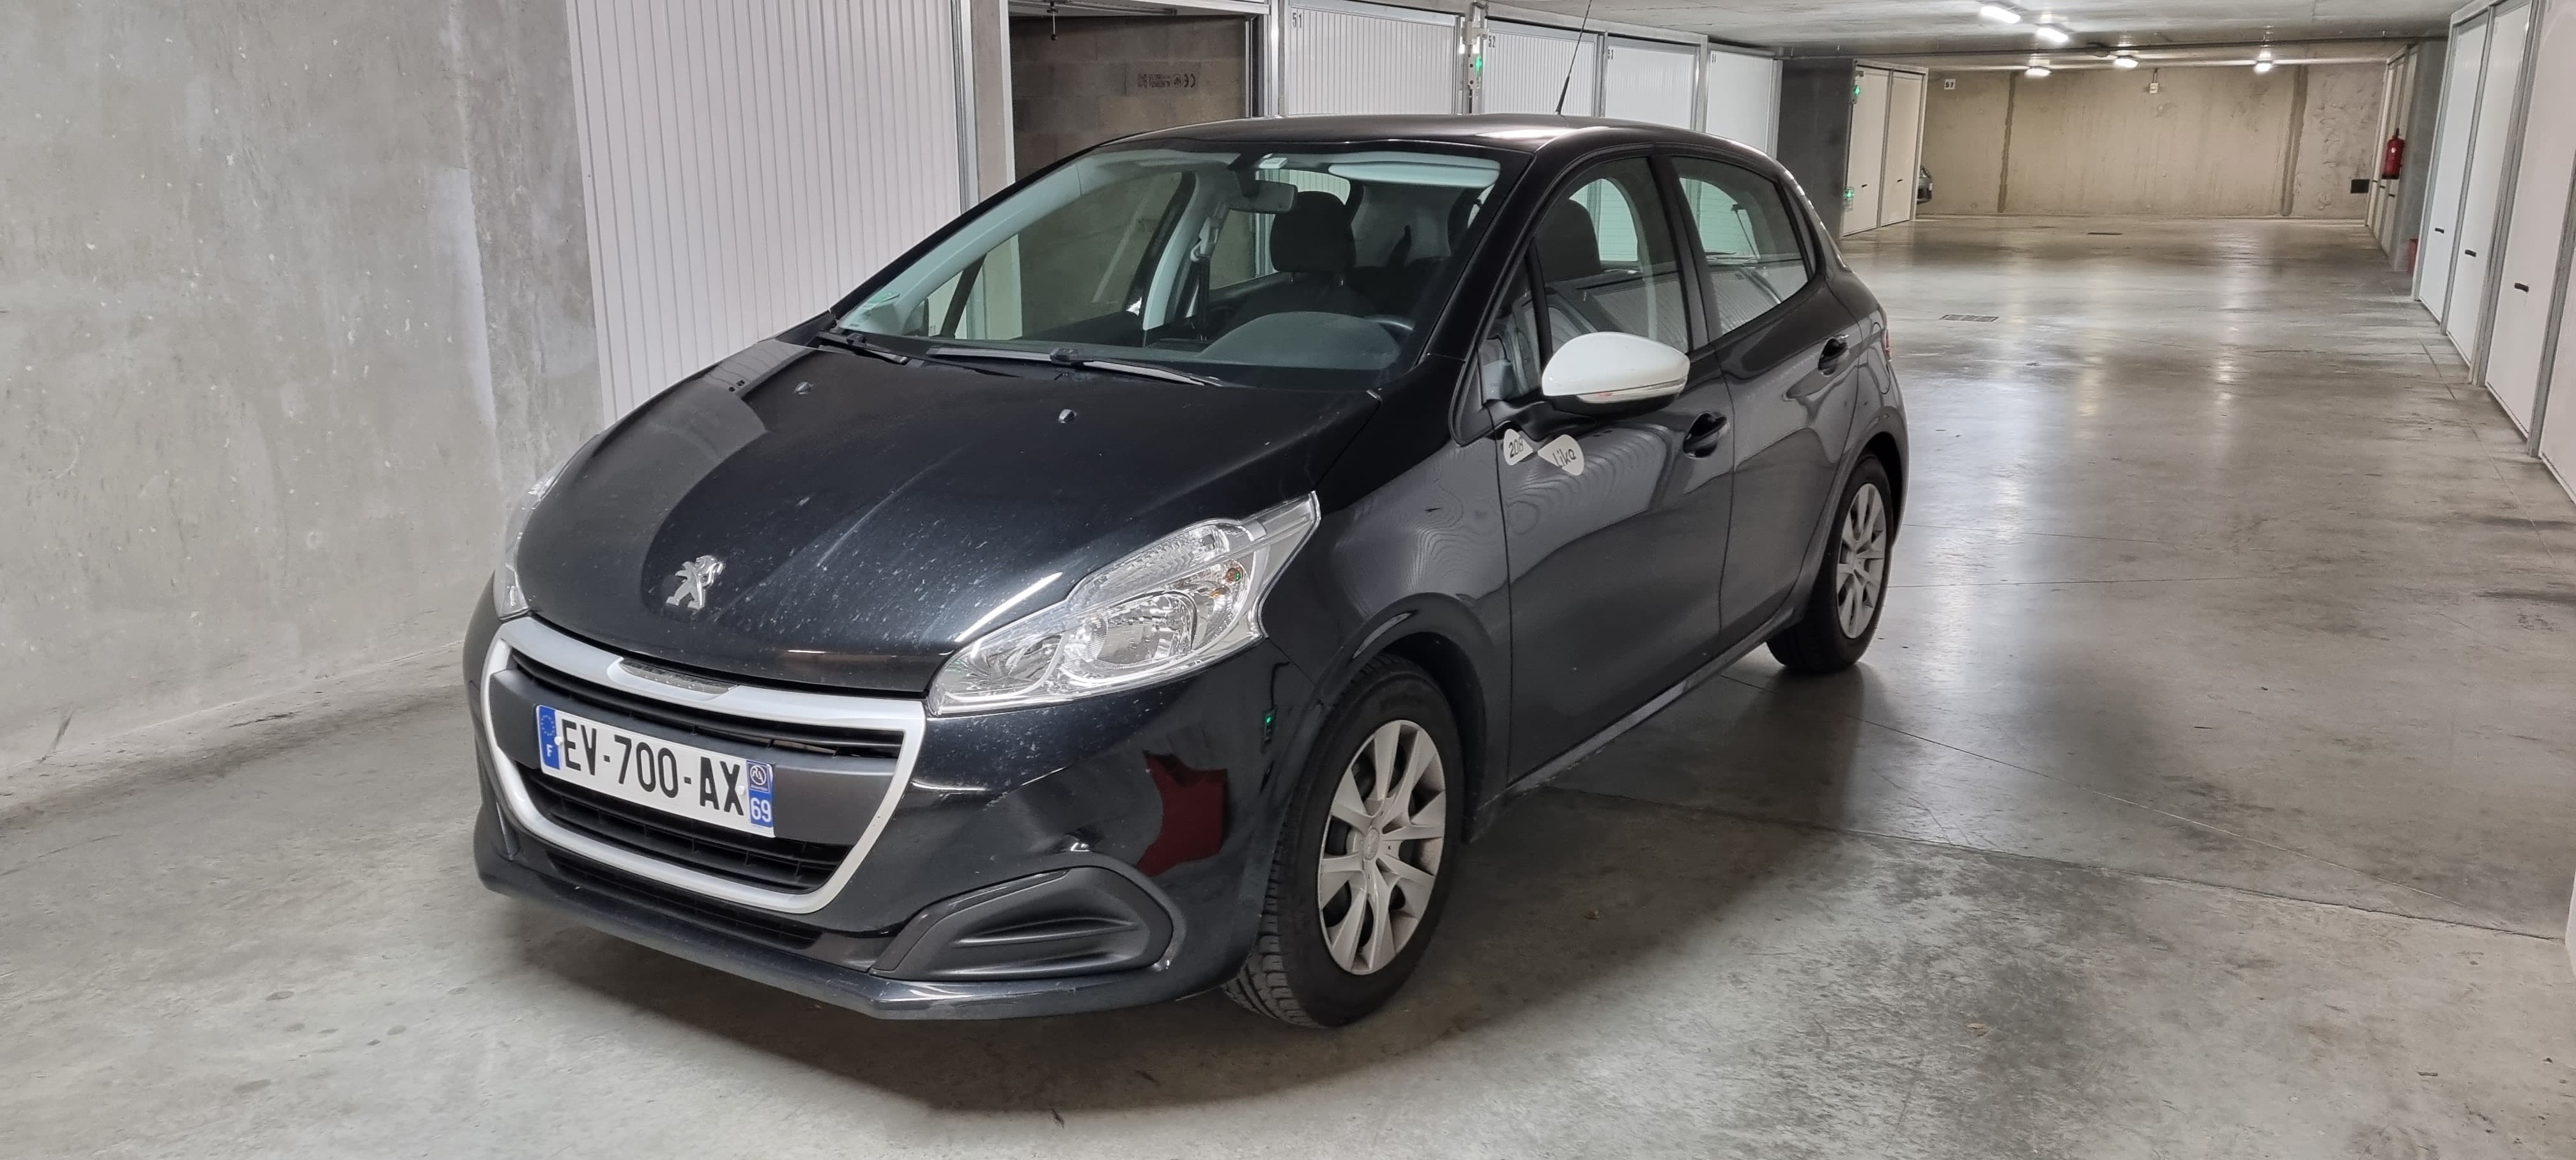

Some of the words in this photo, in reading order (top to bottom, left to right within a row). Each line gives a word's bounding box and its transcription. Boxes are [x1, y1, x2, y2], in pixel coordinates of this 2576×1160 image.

[1292, 12, 1302, 28] 51
[1489, 35, 1496, 48] 52
[1508, 439, 1523, 459] 208
[546, 744, 553, 757] F
[562, 719, 744, 816] EV-700-AX
[751, 797, 772, 823] 69
